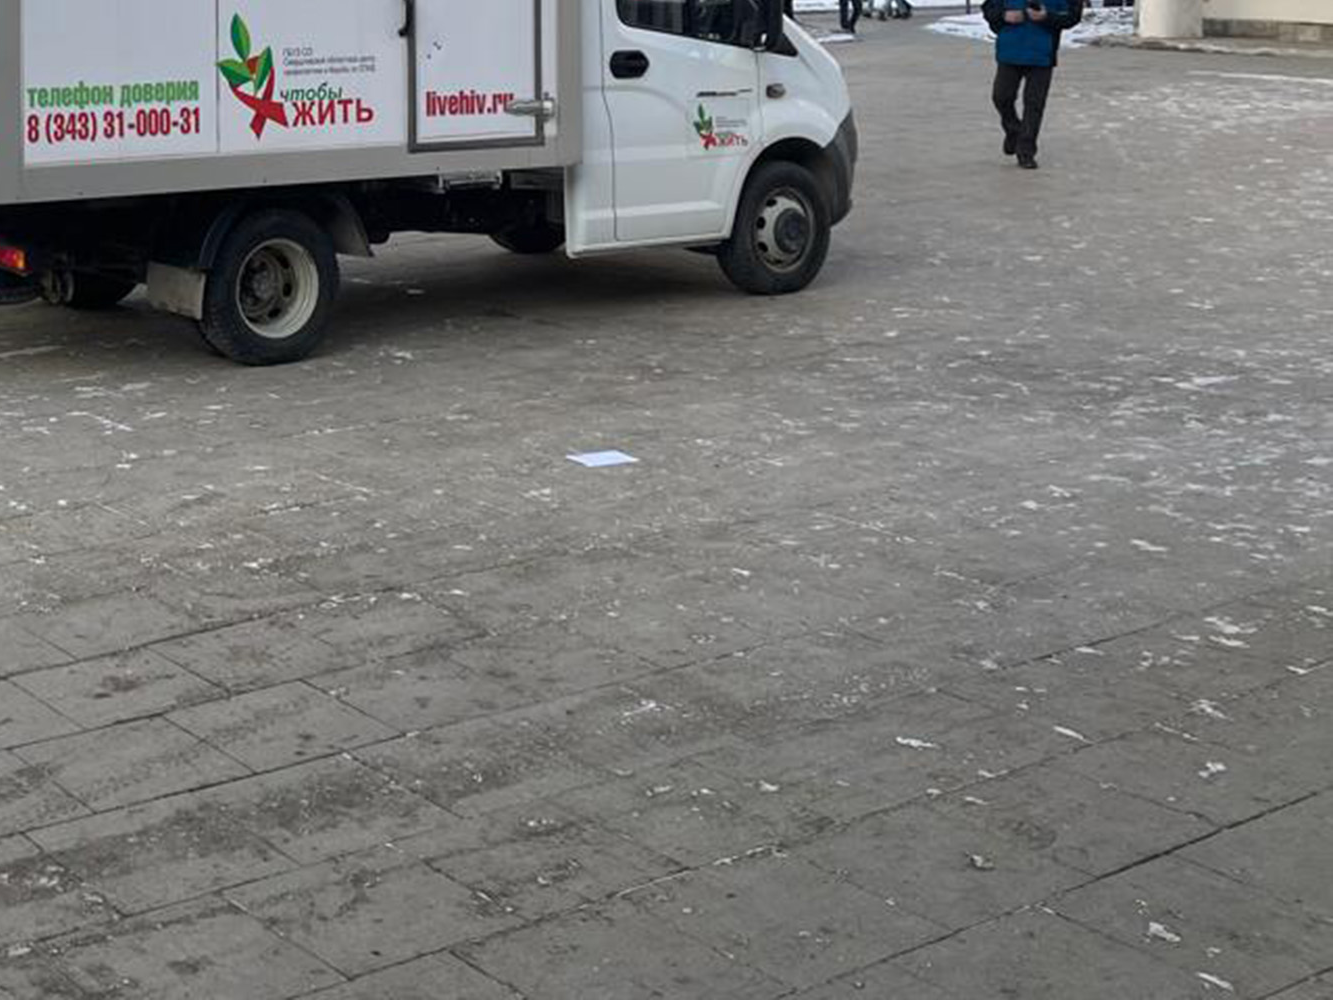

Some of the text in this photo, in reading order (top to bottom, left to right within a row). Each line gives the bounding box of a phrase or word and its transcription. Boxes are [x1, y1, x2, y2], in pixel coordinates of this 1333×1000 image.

[26, 80, 200, 109] телефон доверия
[280, 80, 343, 103] чтобы
[27, 106, 201, 144] 8 (343) 31-000-31
[291, 97, 374, 128] ЖИТЬ
